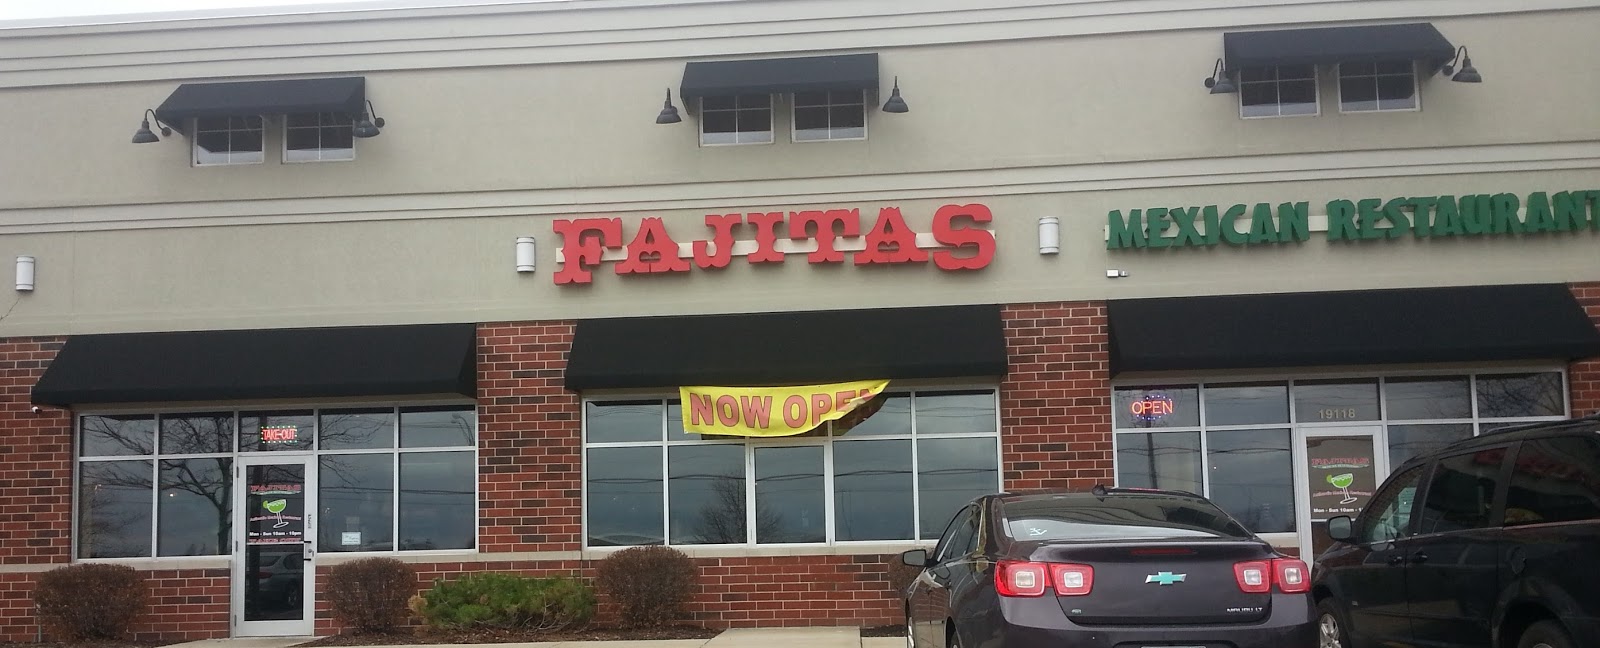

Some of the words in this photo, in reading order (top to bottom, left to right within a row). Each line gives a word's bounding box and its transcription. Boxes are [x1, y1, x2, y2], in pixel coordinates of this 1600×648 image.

[1106, 201, 1311, 250] MEXICAN
[552, 203, 997, 285] FAJITAS
[690, 393, 773, 429] NOW
[1131, 400, 1173, 415] OPEN
[1319, 408, 1356, 419] 19118
[262, 429, 296, 440] TAKE-OUT
